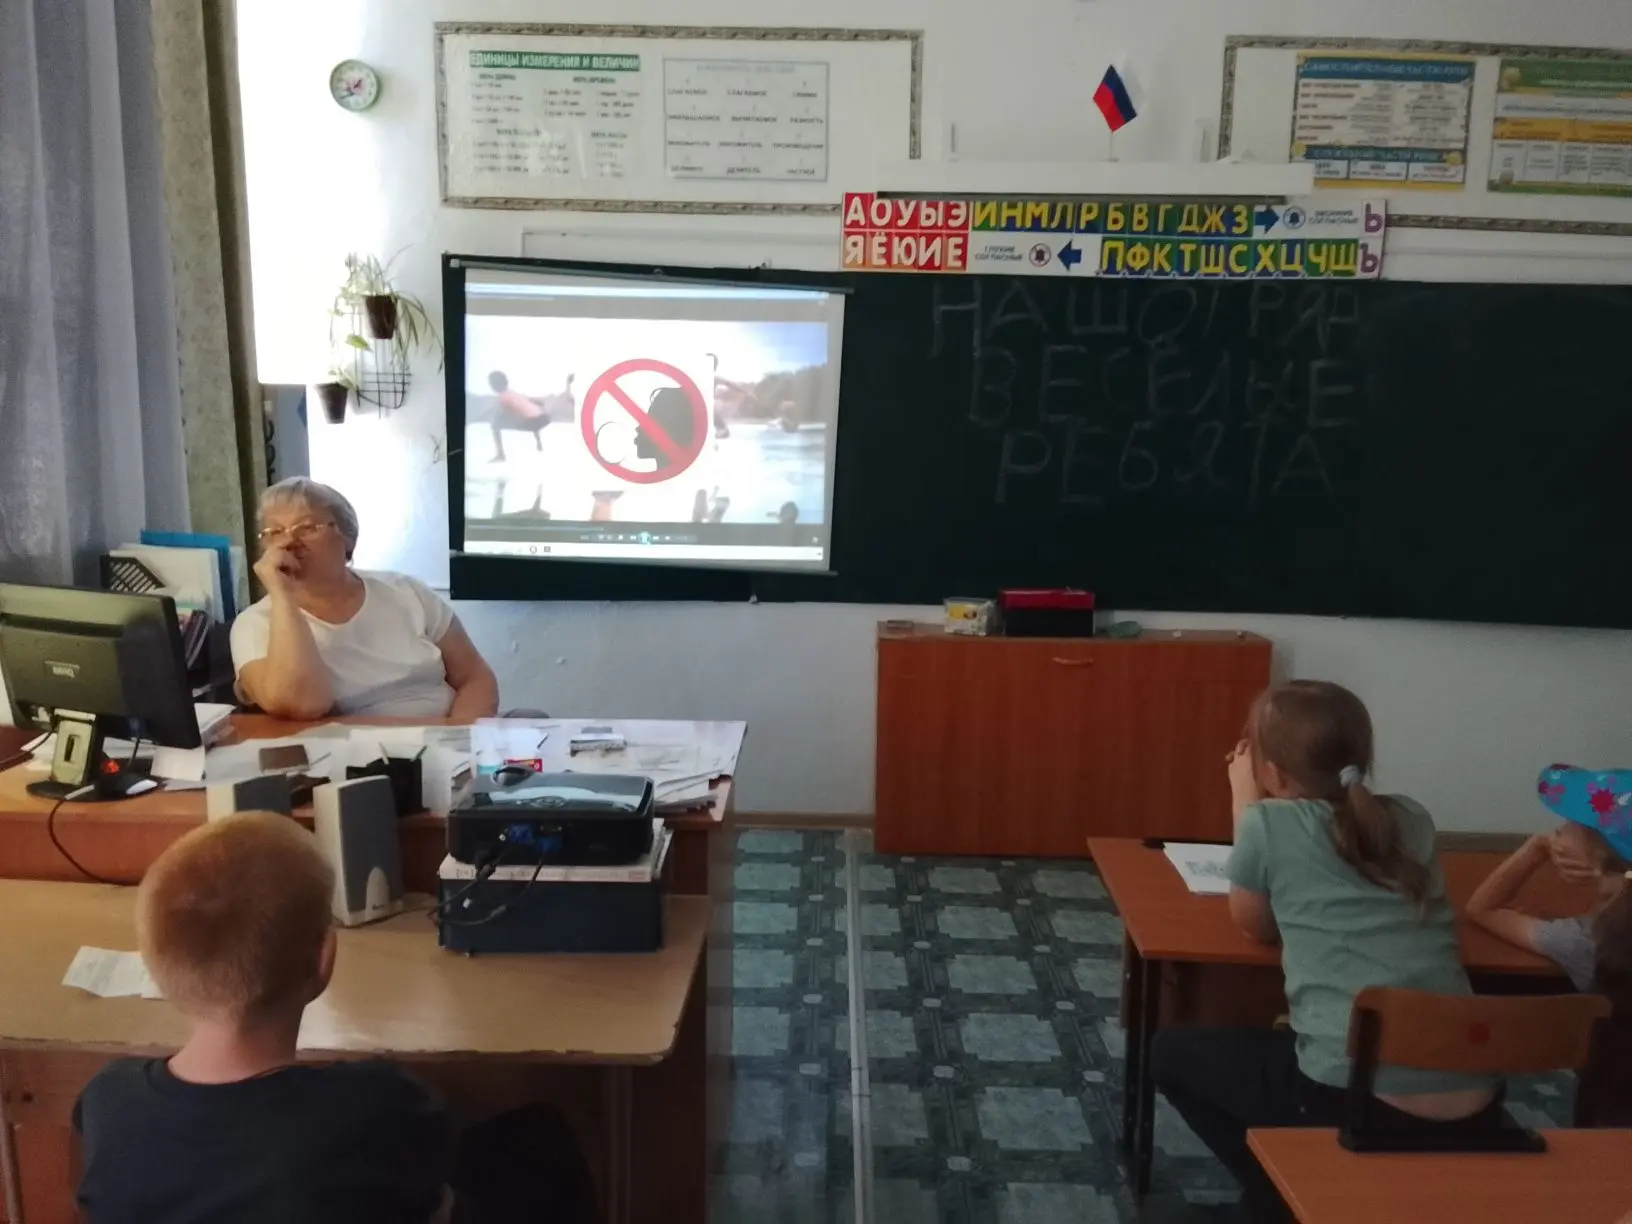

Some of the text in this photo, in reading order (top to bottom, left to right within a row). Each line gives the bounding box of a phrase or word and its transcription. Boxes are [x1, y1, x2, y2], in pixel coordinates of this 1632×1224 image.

[470, 51, 519, 68] ЕДИНИЦЫ
[522, 54, 580, 69] ИЗМЕРЕНИЯ
[582, 56, 590, 68] И
[994, 419, 1335, 510] РЕБЯТА
